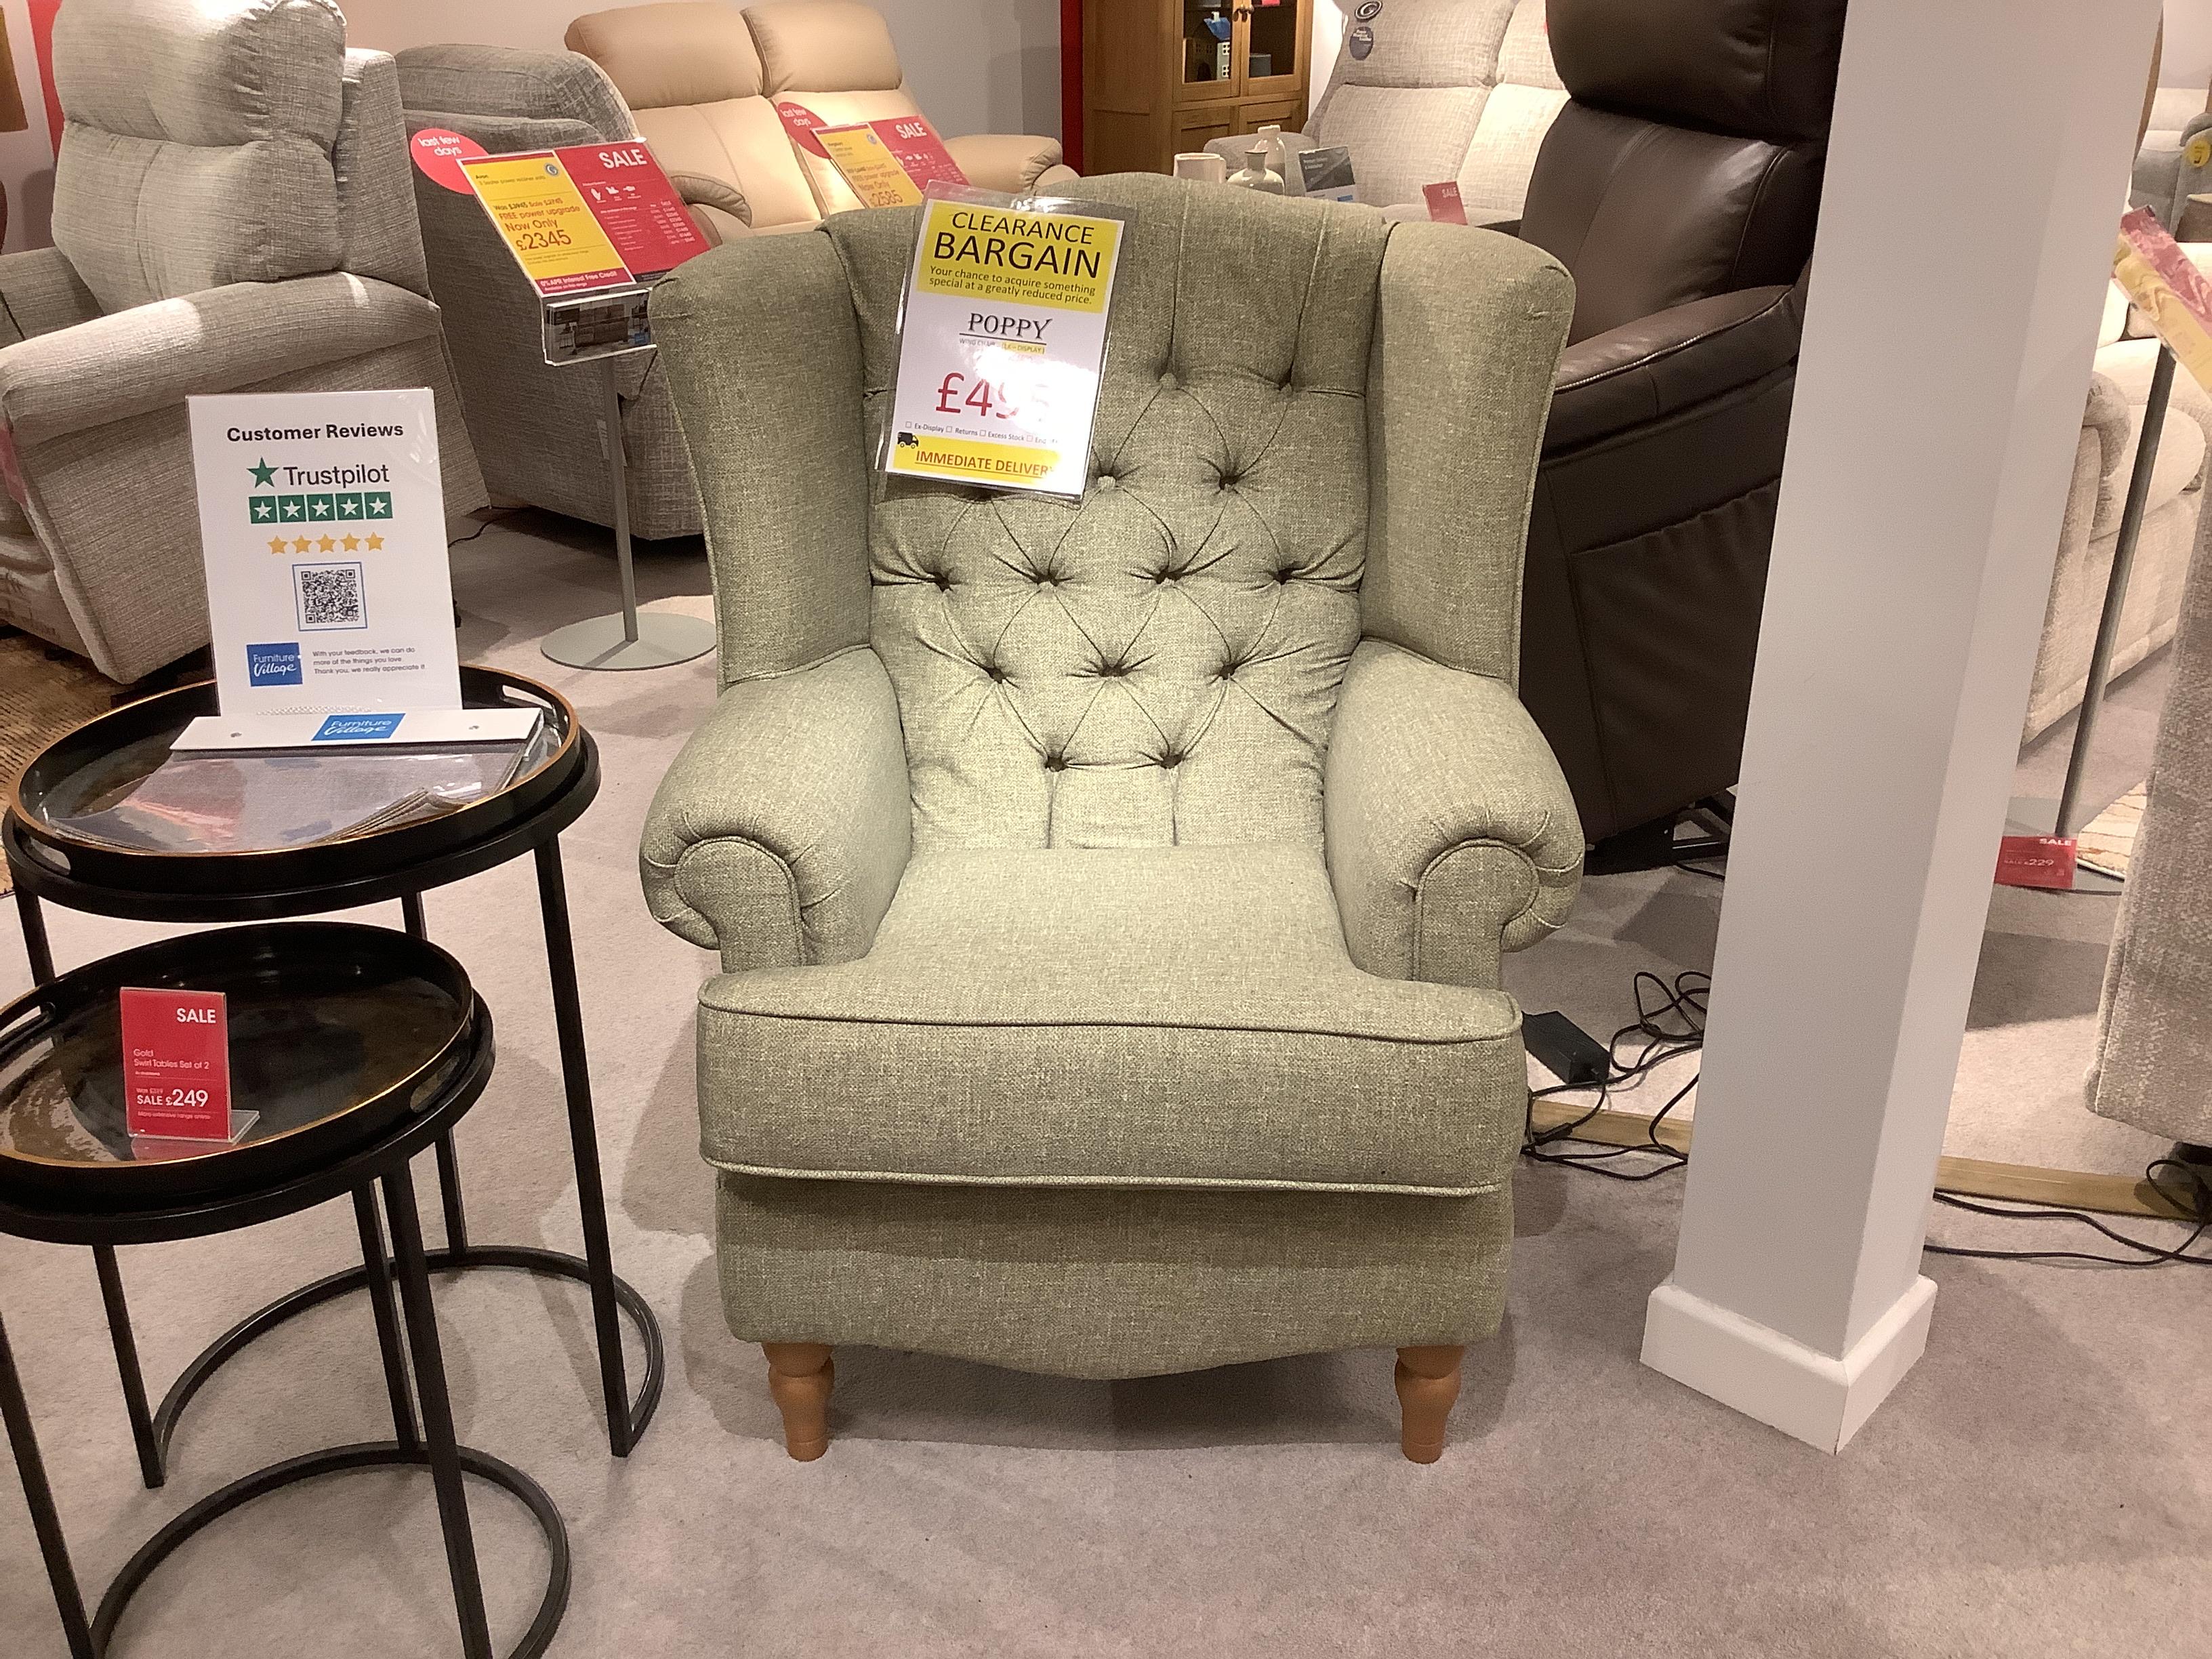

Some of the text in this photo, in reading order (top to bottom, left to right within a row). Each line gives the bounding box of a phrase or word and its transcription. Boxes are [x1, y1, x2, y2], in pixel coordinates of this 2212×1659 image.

[895, 122, 927, 140] SALE
[417, 136, 459, 146] last few
[434, 146, 462, 157] days
[598, 149, 647, 169] SALE
[1441, 187, 1458, 198] SALE
[499, 205, 580, 220] FREE power upgrade
[505, 218, 558, 232] Now Only
[952, 211, 1094, 244] CLEARANCE
[516, 229, 571, 251] £2345
[934, 232, 1101, 279] BARGAIN
[930, 265, 1096, 296] Your chance to acquire something
[929, 277, 962, 289] special
[965, 280, 975, 290] at
[985, 283, 1019, 297] greatly
[1022, 288, 1062, 302] reduced
[1065, 293, 1092, 305] price.
[968, 312, 1052, 340] POPPY
[227, 423, 404, 442] Customer Reviews
[914, 424, 944, 434] Ex-Display
[1008, 433, 1024, 441] Stock
[916, 451, 1053, 476] IMMEDIATE DELIVER
[283, 464, 390, 488] Trustpilot
[253, 654, 294, 663] Furniture
[253, 663, 298, 677] Village
[324, 726, 388, 736] Village
[331, 719, 392, 727] Furniture
[177, 1008, 216, 1023] SALE
[134, 1048, 154, 1057] Gold
[134, 1058, 151, 1066] Swirl
[152, 1059, 178, 1067] Tables
[180, 1060, 192, 1068] Set
[204, 1061, 209, 1069] 2
[137, 1088, 208, 1107] SALE £249
